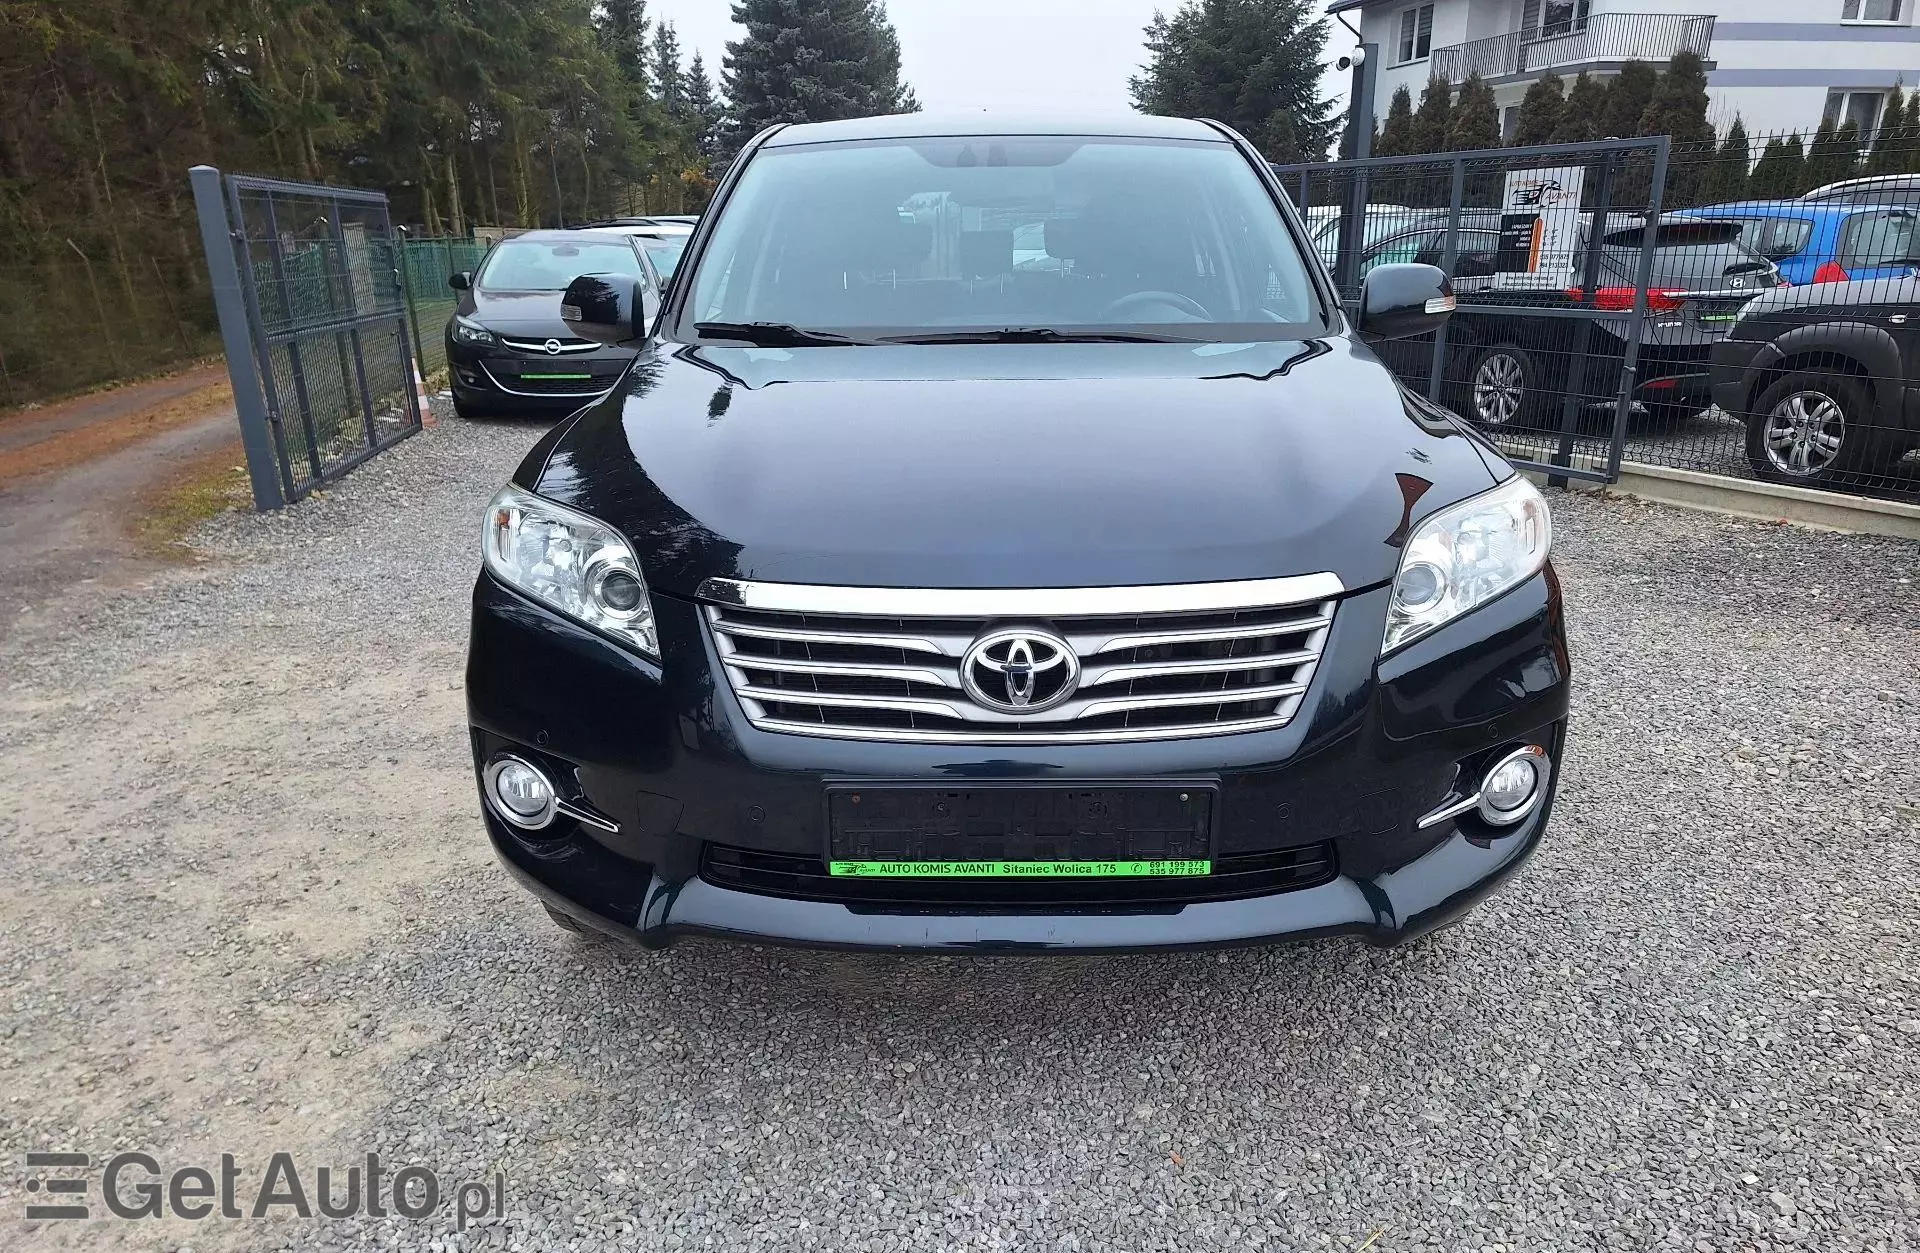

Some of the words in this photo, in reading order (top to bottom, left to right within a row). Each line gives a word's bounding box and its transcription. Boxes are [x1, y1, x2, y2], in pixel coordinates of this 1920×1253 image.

[879, 863, 911, 874] AUTO
[914, 863, 951, 874] KOMIS
[954, 863, 995, 874] AVANTI
[1002, 863, 1050, 874] Sitaniec
[1053, 863, 1092, 874] Wolica
[1096, 863, 1117, 874] 175
